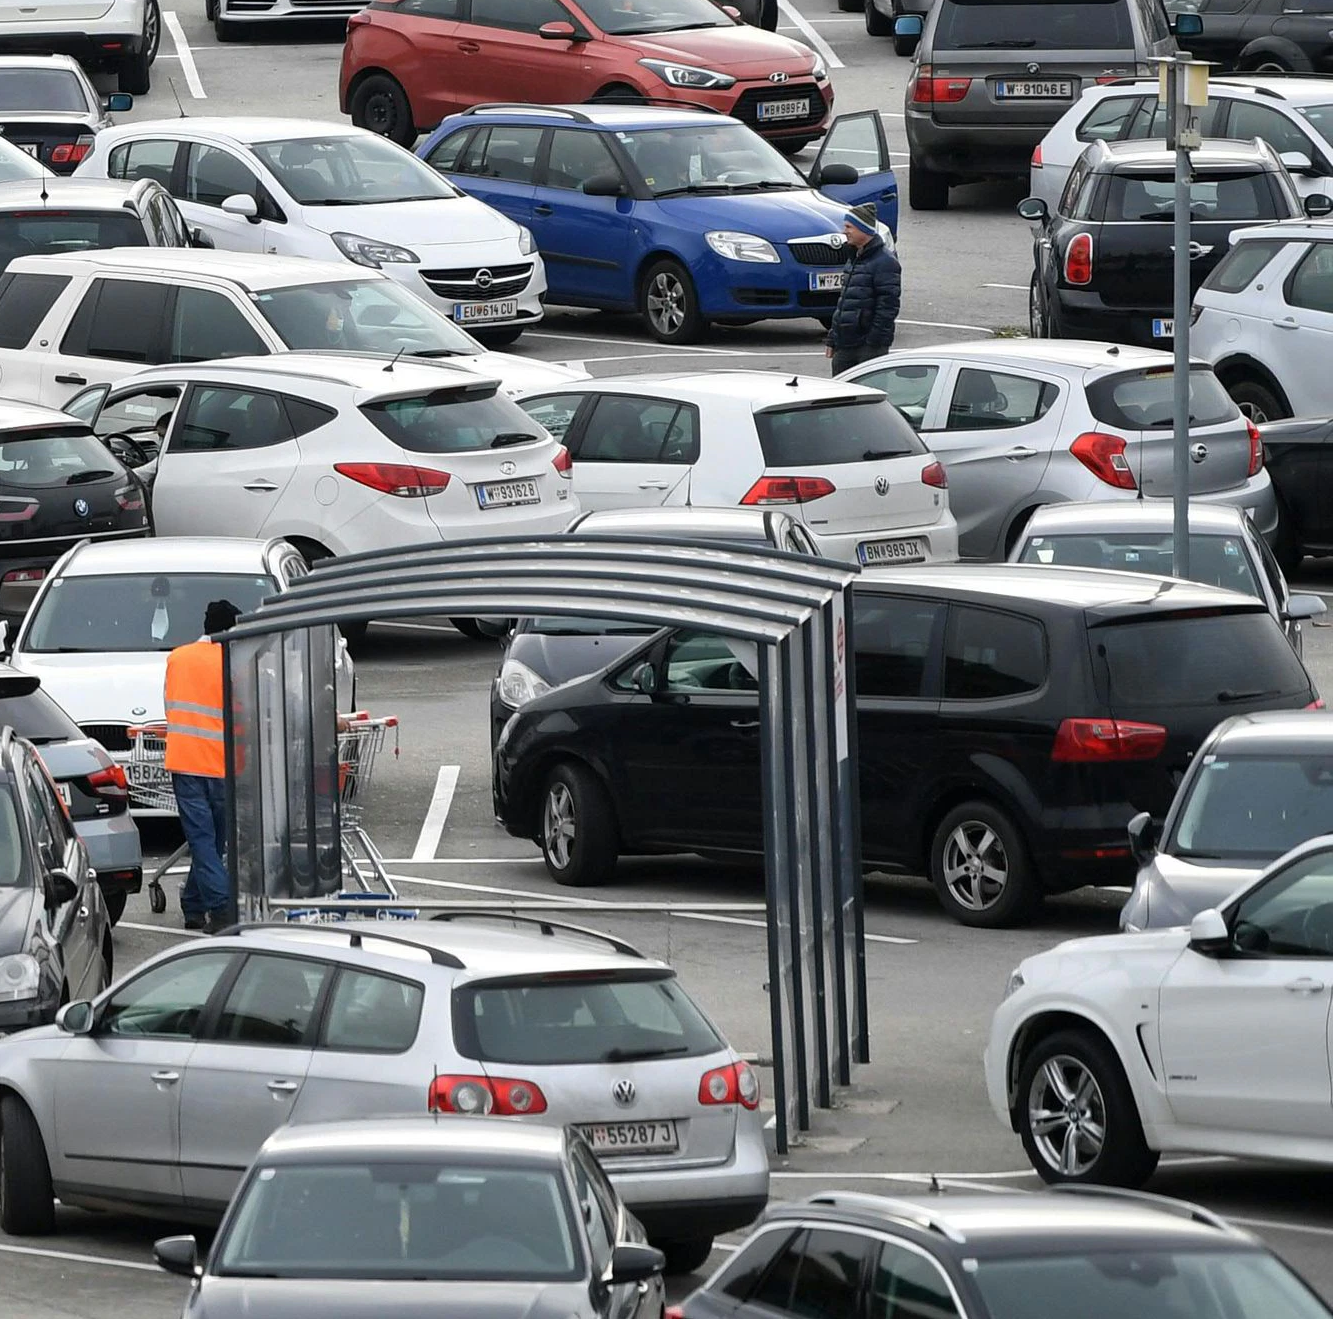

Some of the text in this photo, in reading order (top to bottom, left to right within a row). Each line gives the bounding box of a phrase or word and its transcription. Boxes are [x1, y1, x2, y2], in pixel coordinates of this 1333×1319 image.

[1007, 84, 1015, 95] W
[1024, 84, 1058, 95] 91046
[818, 276, 826, 287] W
[464, 303, 514, 318] EU 614 CU
[1164, 322, 1173, 335] W
[486, 488, 494, 501] W
[867, 542, 920, 559] BN 989 JX
[583, 1124, 672, 1147] W 55287 J
